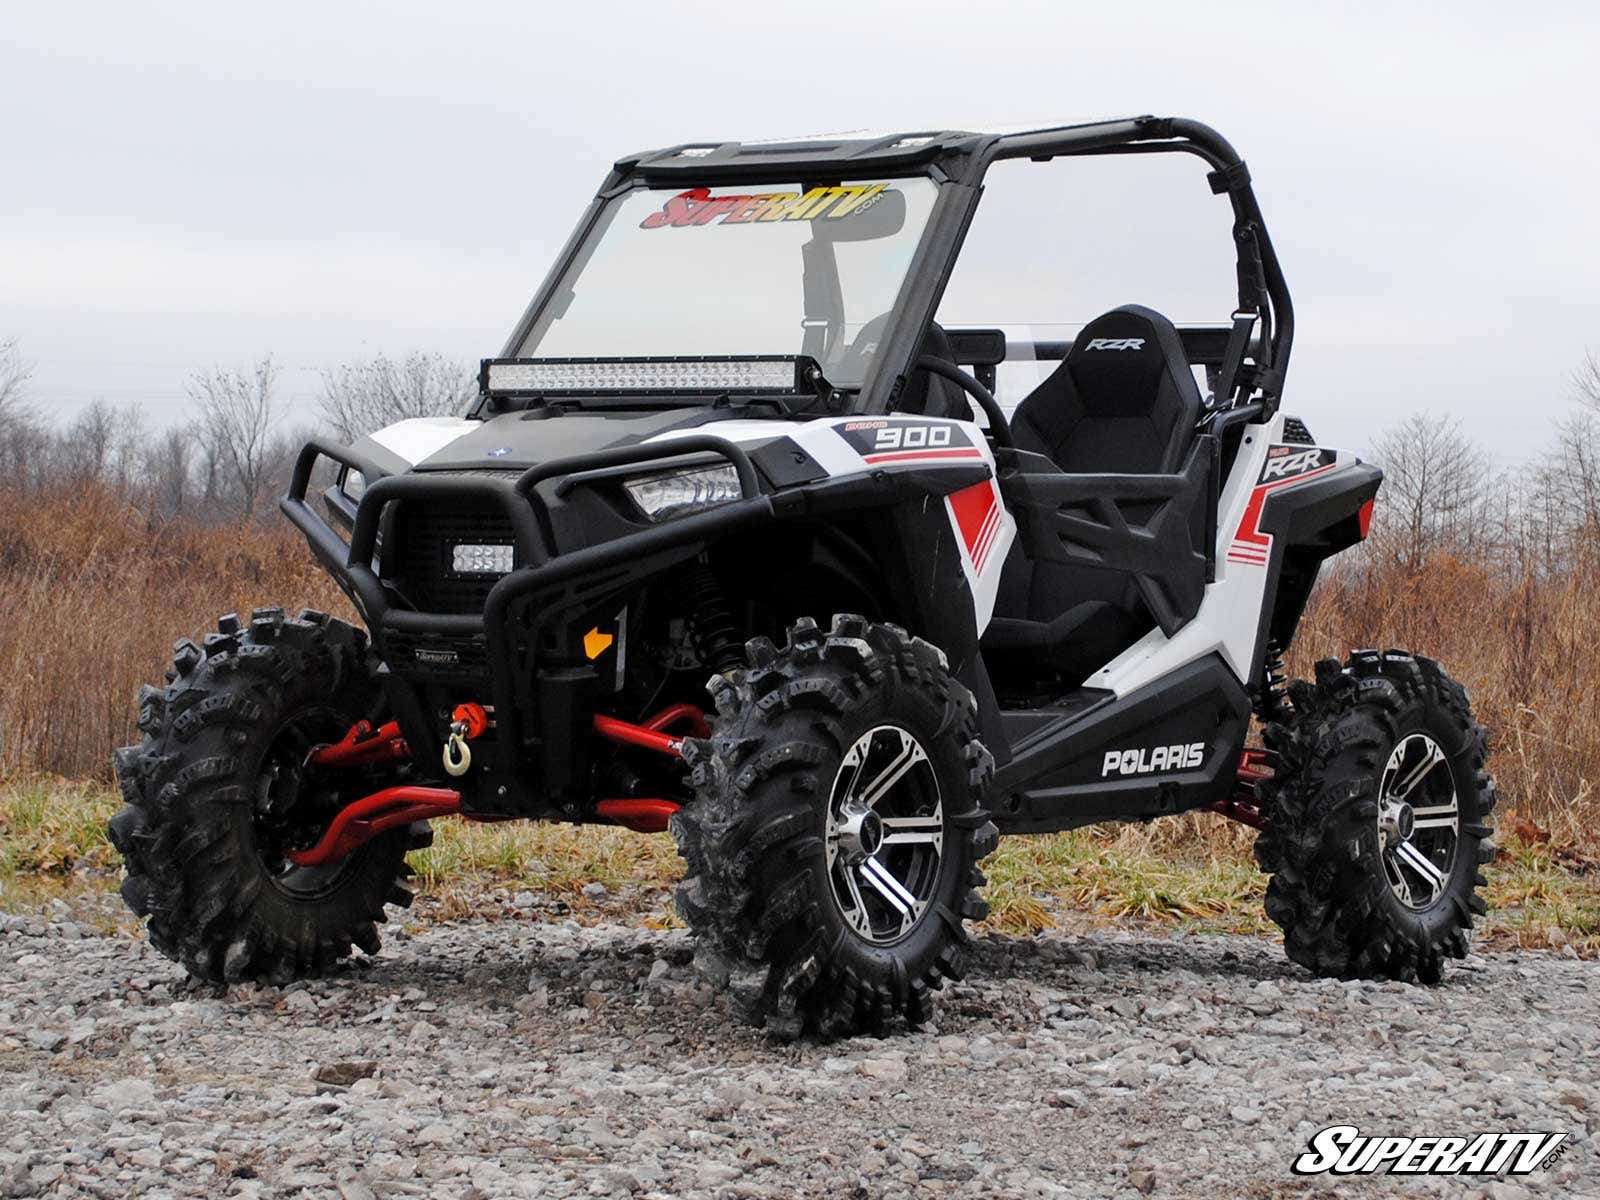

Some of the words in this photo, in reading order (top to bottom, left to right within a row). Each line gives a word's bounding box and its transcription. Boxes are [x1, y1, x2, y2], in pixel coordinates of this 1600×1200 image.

[1084, 338, 1146, 352] RZR
[874, 426, 952, 450] 900
[1262, 448, 1322, 482] RZR
[1101, 742, 1205, 777] POLARIS
